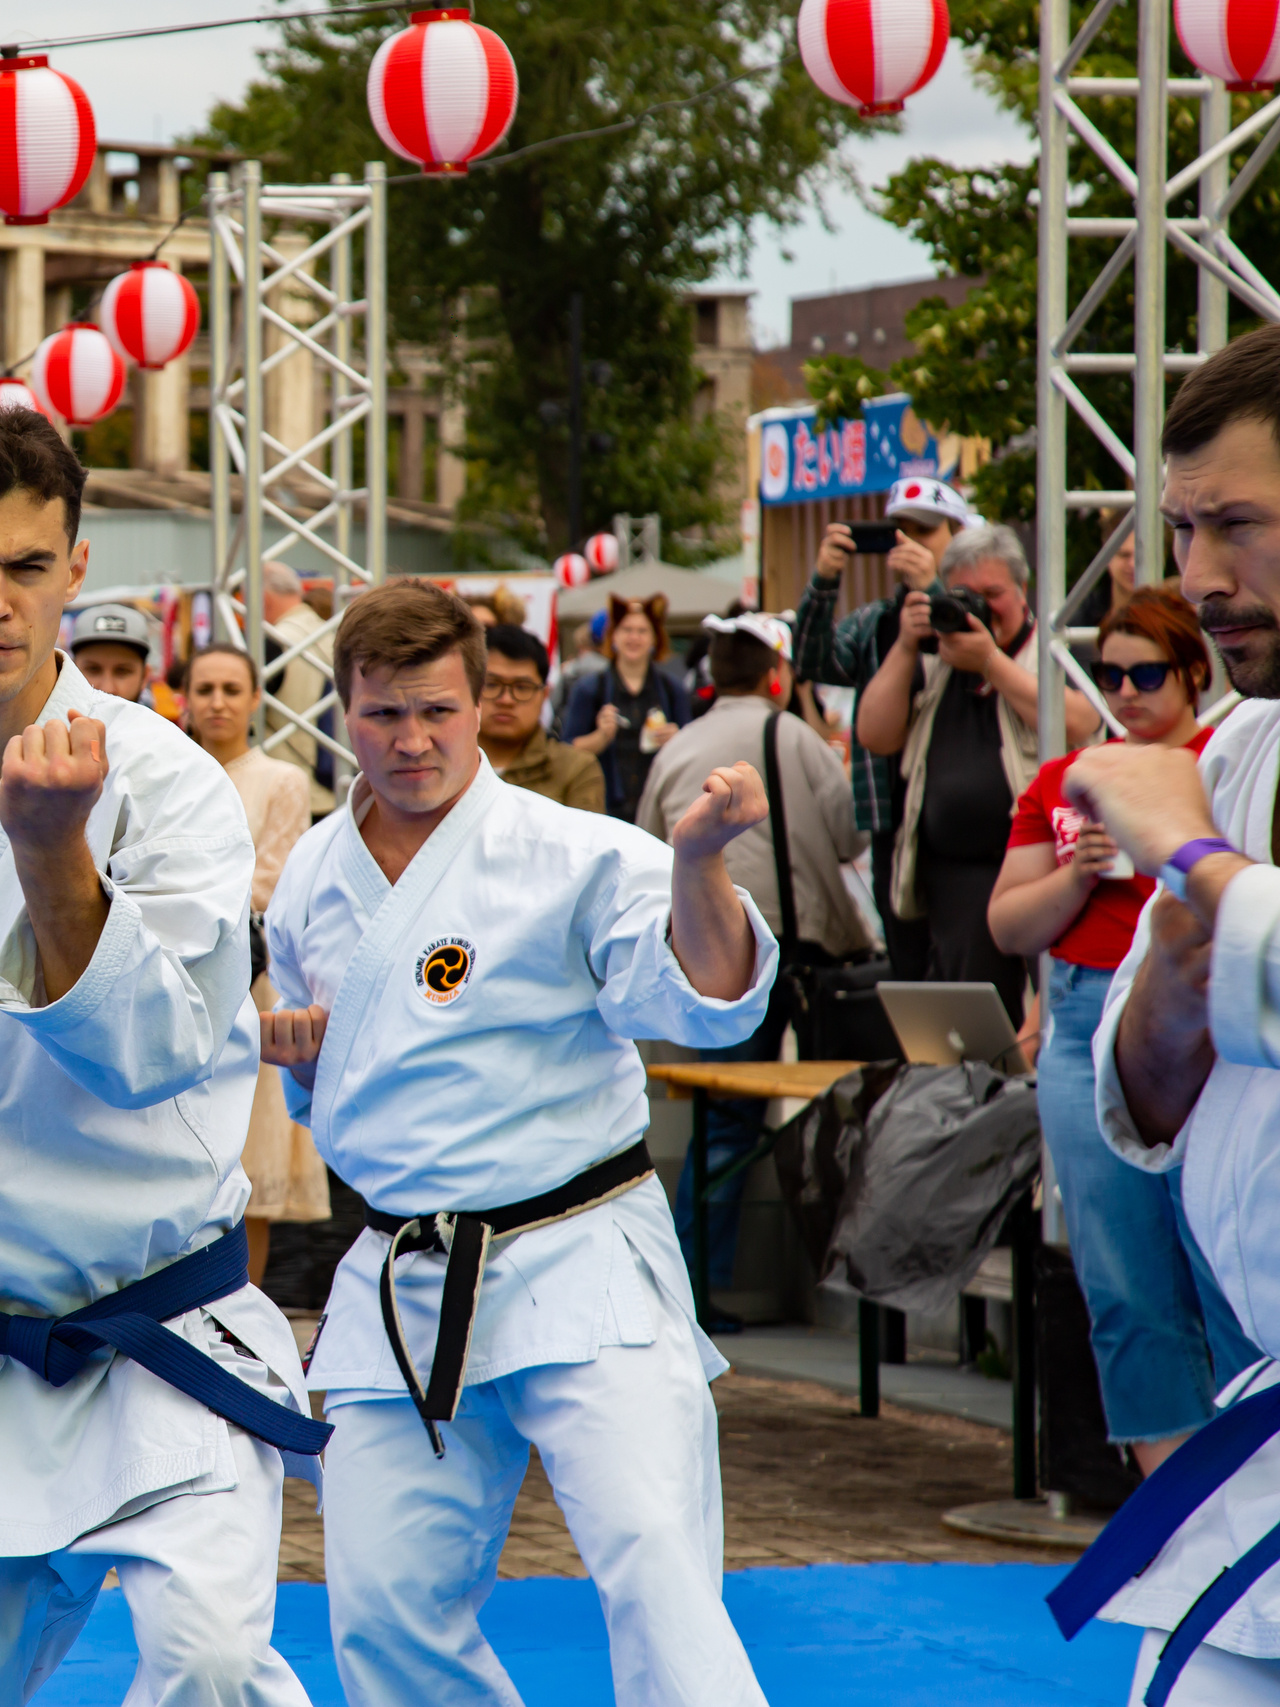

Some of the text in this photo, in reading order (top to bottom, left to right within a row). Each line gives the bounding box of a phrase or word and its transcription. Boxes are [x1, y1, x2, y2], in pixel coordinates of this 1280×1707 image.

[423, 938, 448, 956] KARATE
[451, 938, 471, 949] KOBUDO
[424, 988, 460, 1003] RUSSIA
